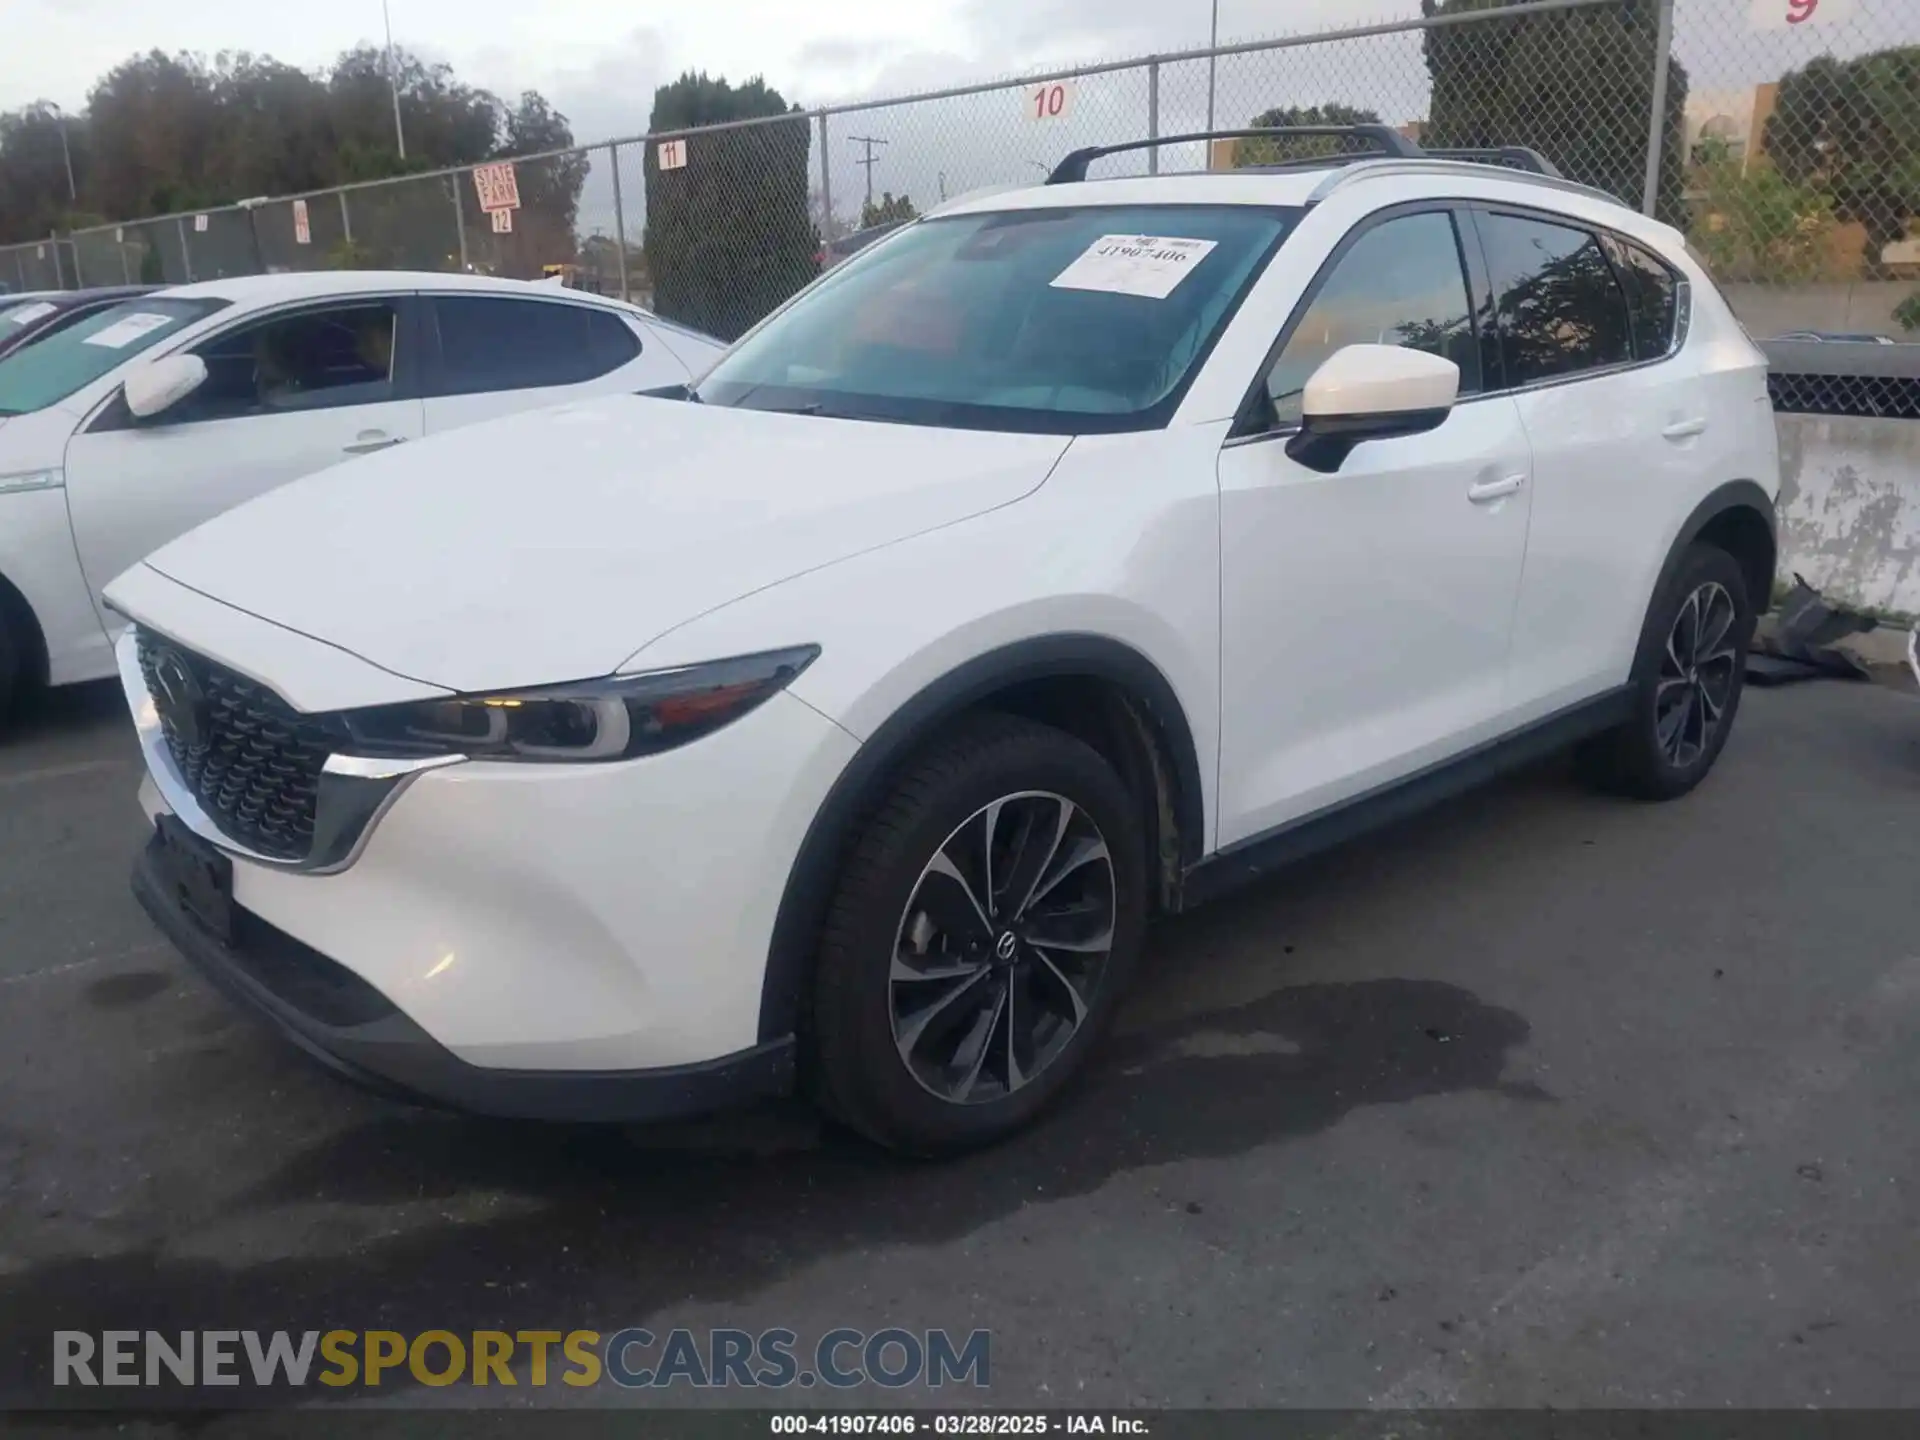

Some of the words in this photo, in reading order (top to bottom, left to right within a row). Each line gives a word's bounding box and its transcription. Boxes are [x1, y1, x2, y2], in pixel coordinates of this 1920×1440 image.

[1034, 86, 1064, 118] 10
[664, 142, 677, 168] 11
[476, 165, 513, 186] STATE
[483, 183, 516, 203] FARM
[495, 210, 510, 230] 12
[1098, 246, 1187, 262] 41907406
